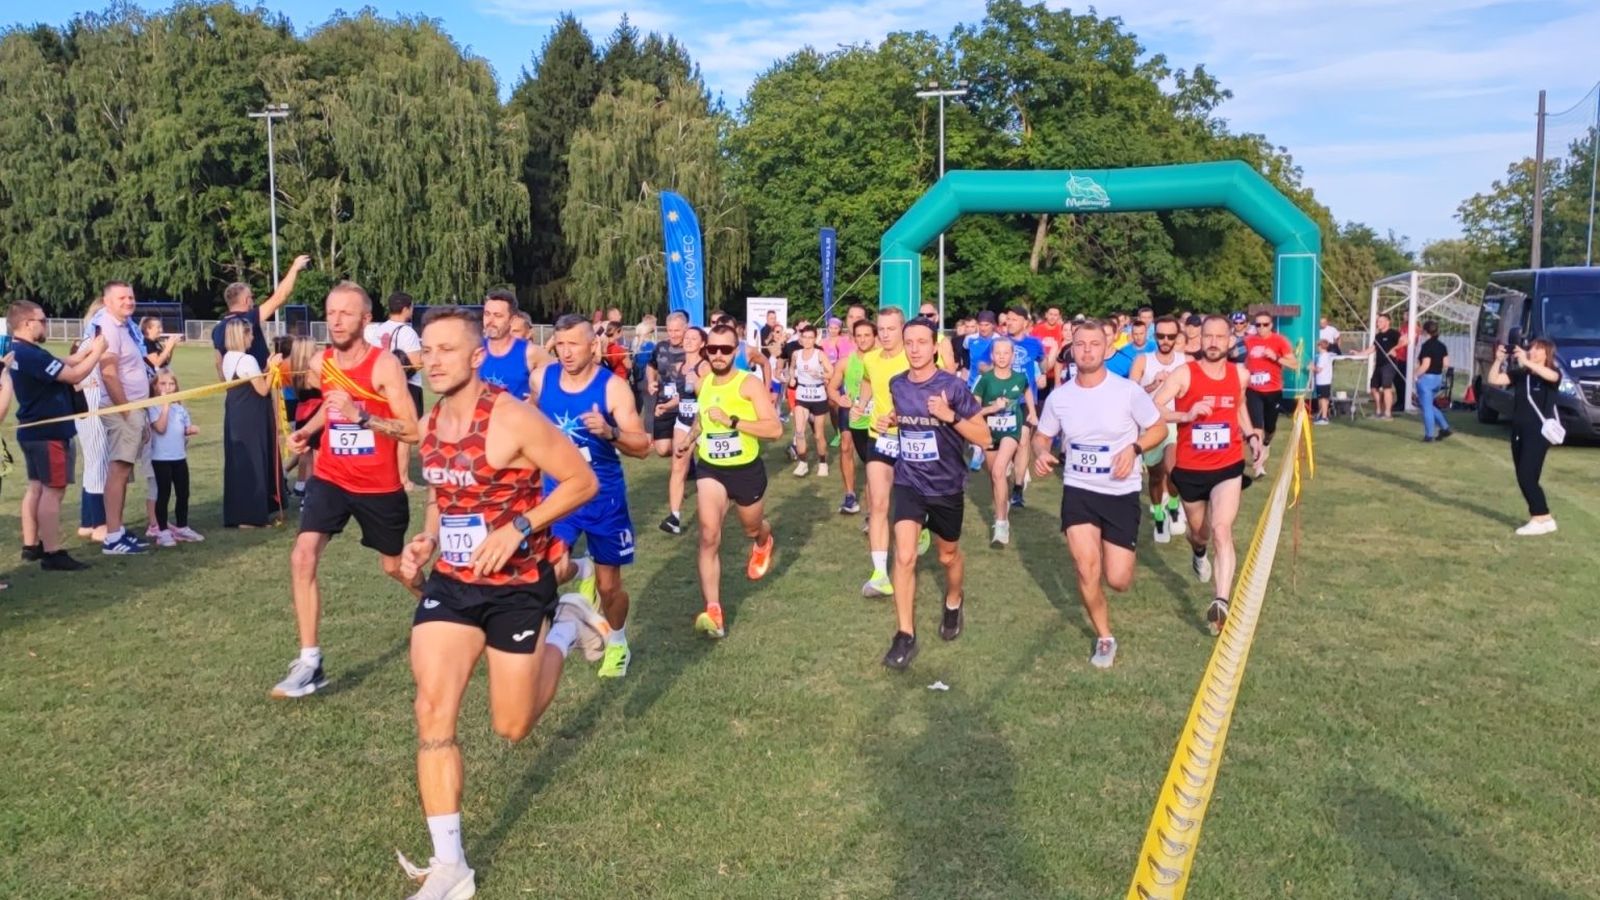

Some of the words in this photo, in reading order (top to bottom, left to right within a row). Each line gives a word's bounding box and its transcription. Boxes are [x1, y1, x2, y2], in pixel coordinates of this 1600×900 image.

[995, 418, 1008, 426] 47
[340, 433, 358, 446] 67
[1203, 432, 1218, 441] 81
[714, 441, 730, 451] 99
[906, 442, 926, 452] 167
[1081, 453, 1097, 465] 89
[447, 533, 473, 549] 170
